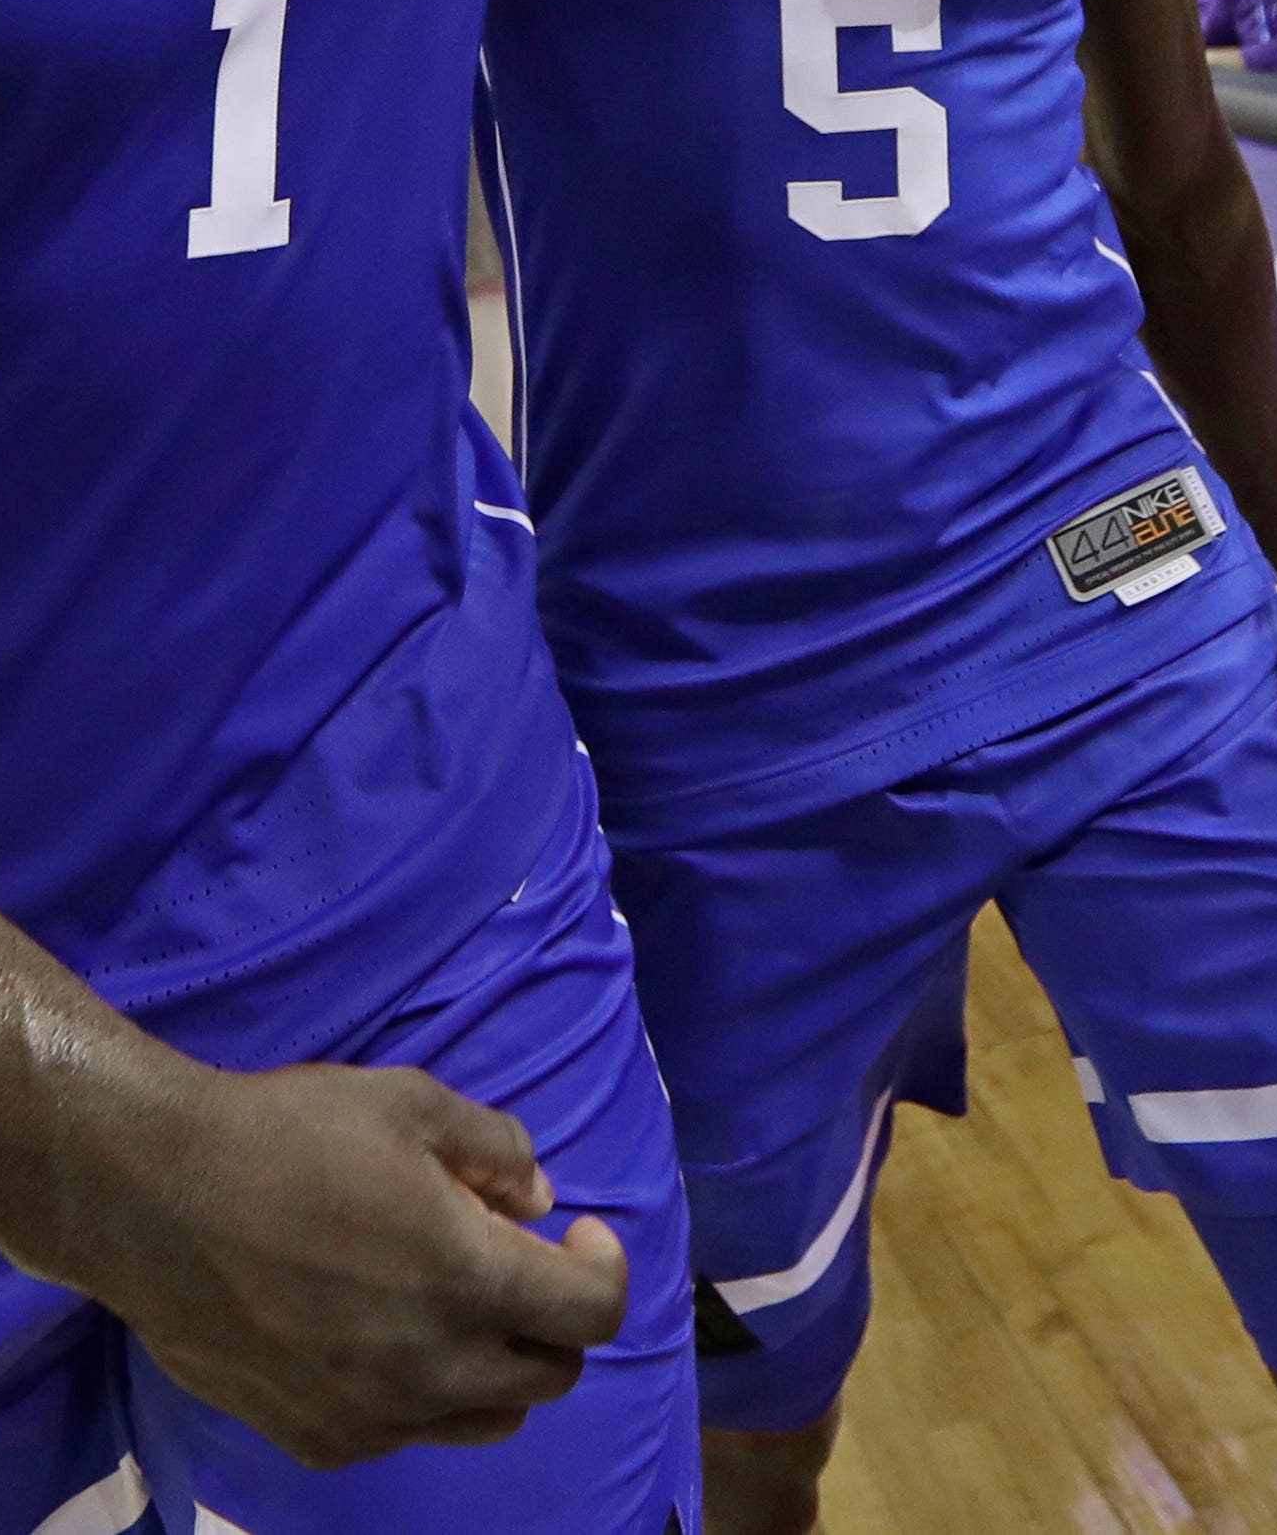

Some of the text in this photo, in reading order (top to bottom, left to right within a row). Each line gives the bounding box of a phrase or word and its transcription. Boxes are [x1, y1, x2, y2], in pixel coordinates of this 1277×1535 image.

[1121, 481, 1187, 527] NIKE
[1130, 501, 1197, 548] ELITE
[1071, 516, 1132, 565] 44
